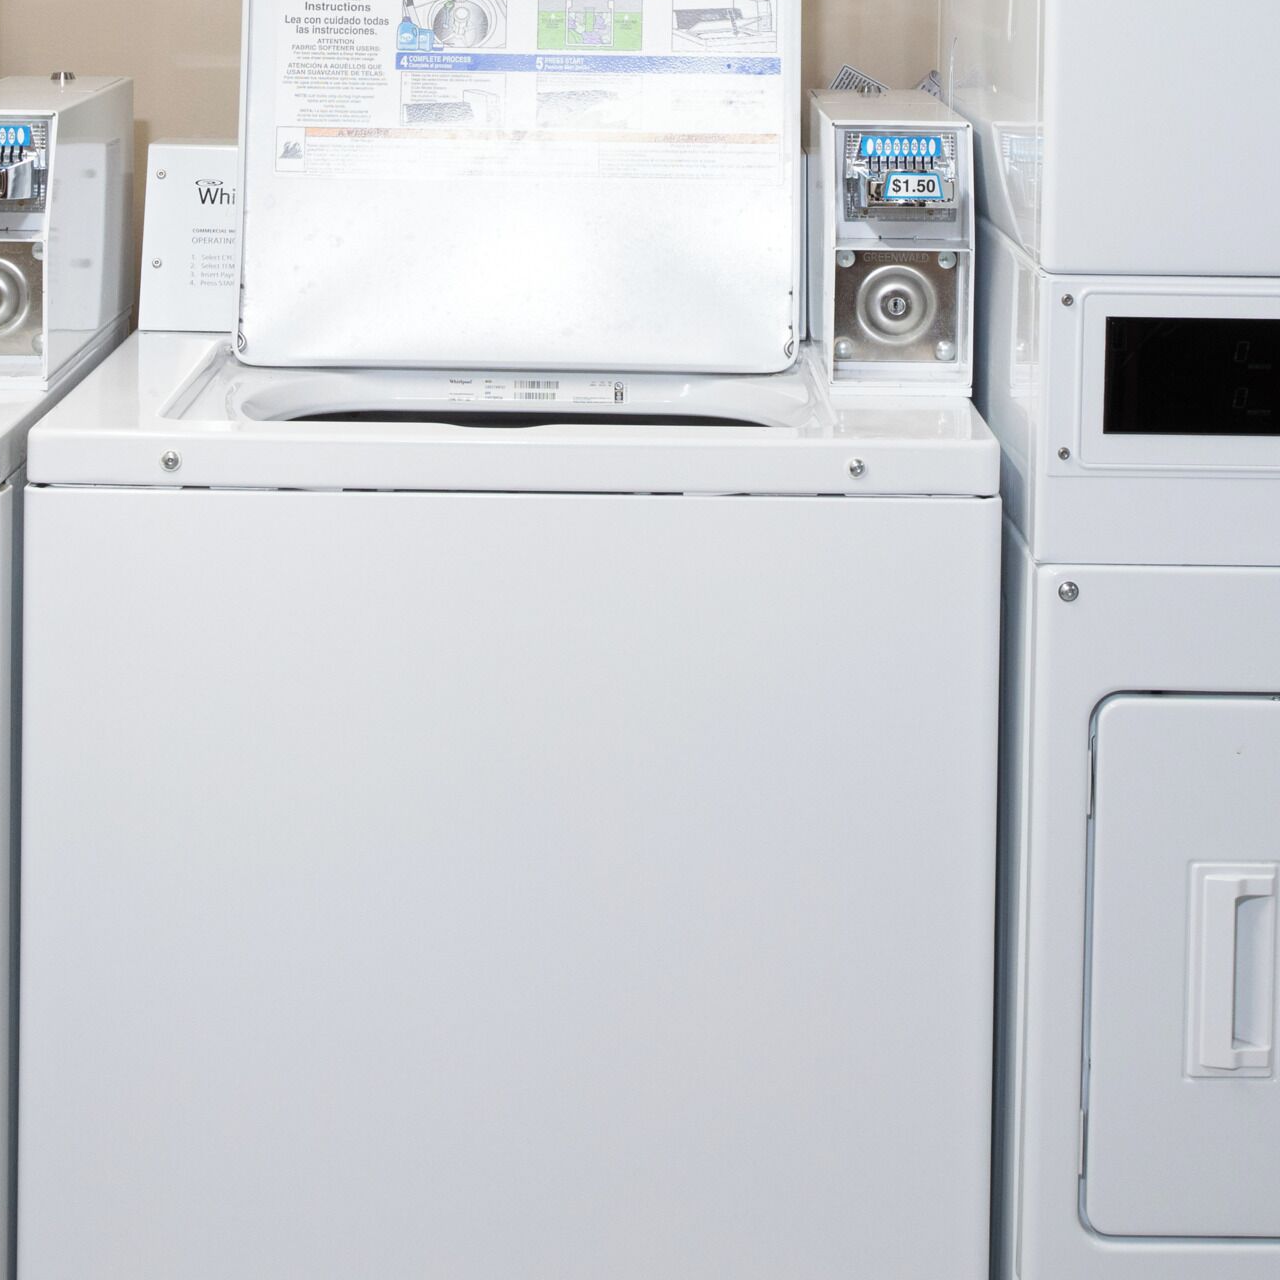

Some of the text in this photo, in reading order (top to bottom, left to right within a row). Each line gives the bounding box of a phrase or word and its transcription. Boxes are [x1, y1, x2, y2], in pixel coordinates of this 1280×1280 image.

[304, 1, 371, 12] Instructions
[284, 15, 390, 26] Lea con cuidado todas
[295, 25, 378, 35] las instrucciones.
[400, 55, 472, 68] 4 COMPLETE PROCESS
[535, 57, 543, 70] 5
[892, 178, 936, 195] $1.50
[863, 252, 929, 263] GREENWALD
